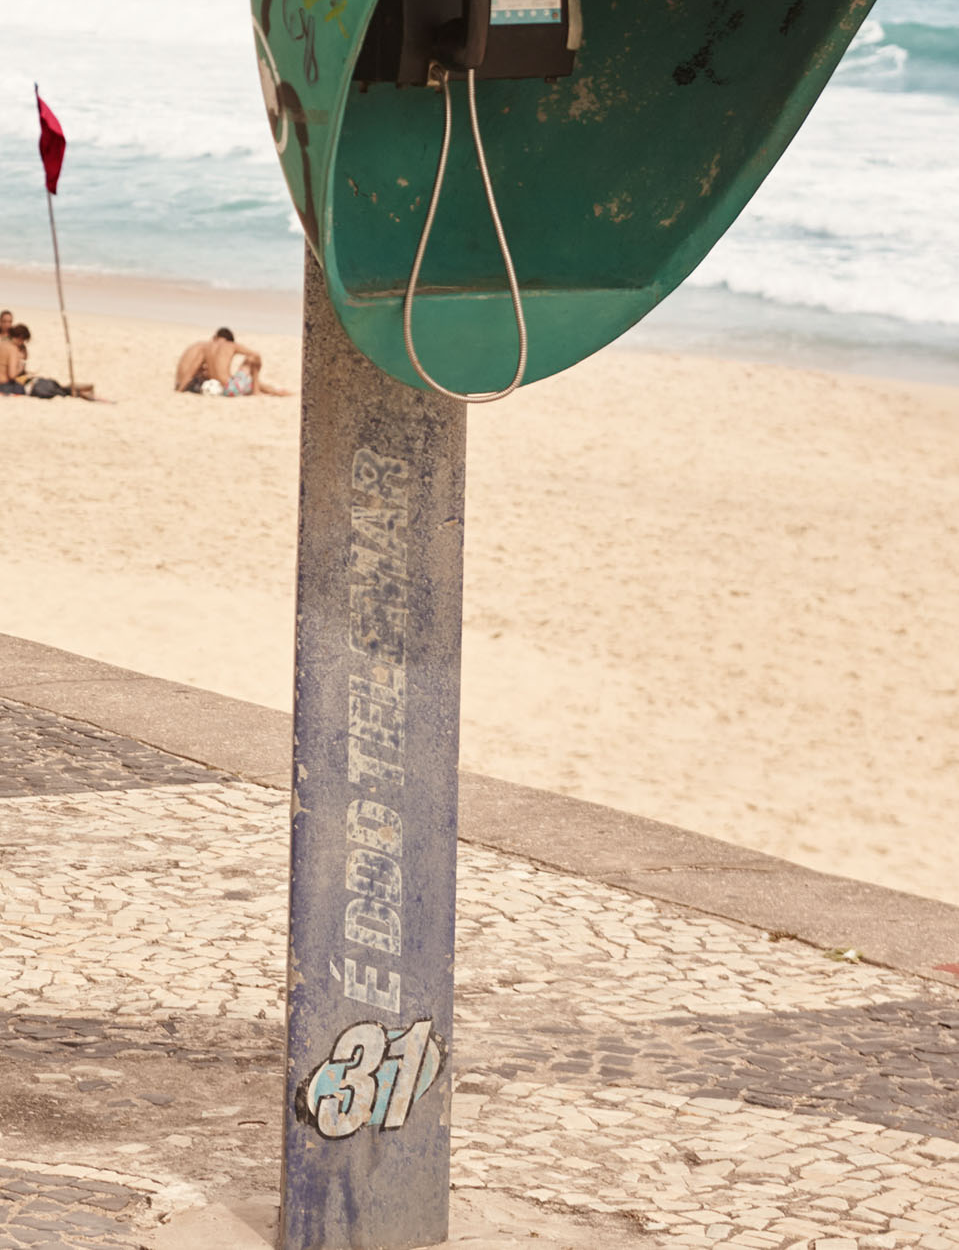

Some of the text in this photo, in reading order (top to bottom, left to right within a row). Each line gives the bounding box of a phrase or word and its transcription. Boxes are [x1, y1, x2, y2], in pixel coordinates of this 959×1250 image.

[347, 448, 409, 787] TELEMAR
[344, 798, 403, 957] DDD
[314, 1017, 434, 1141] 31
